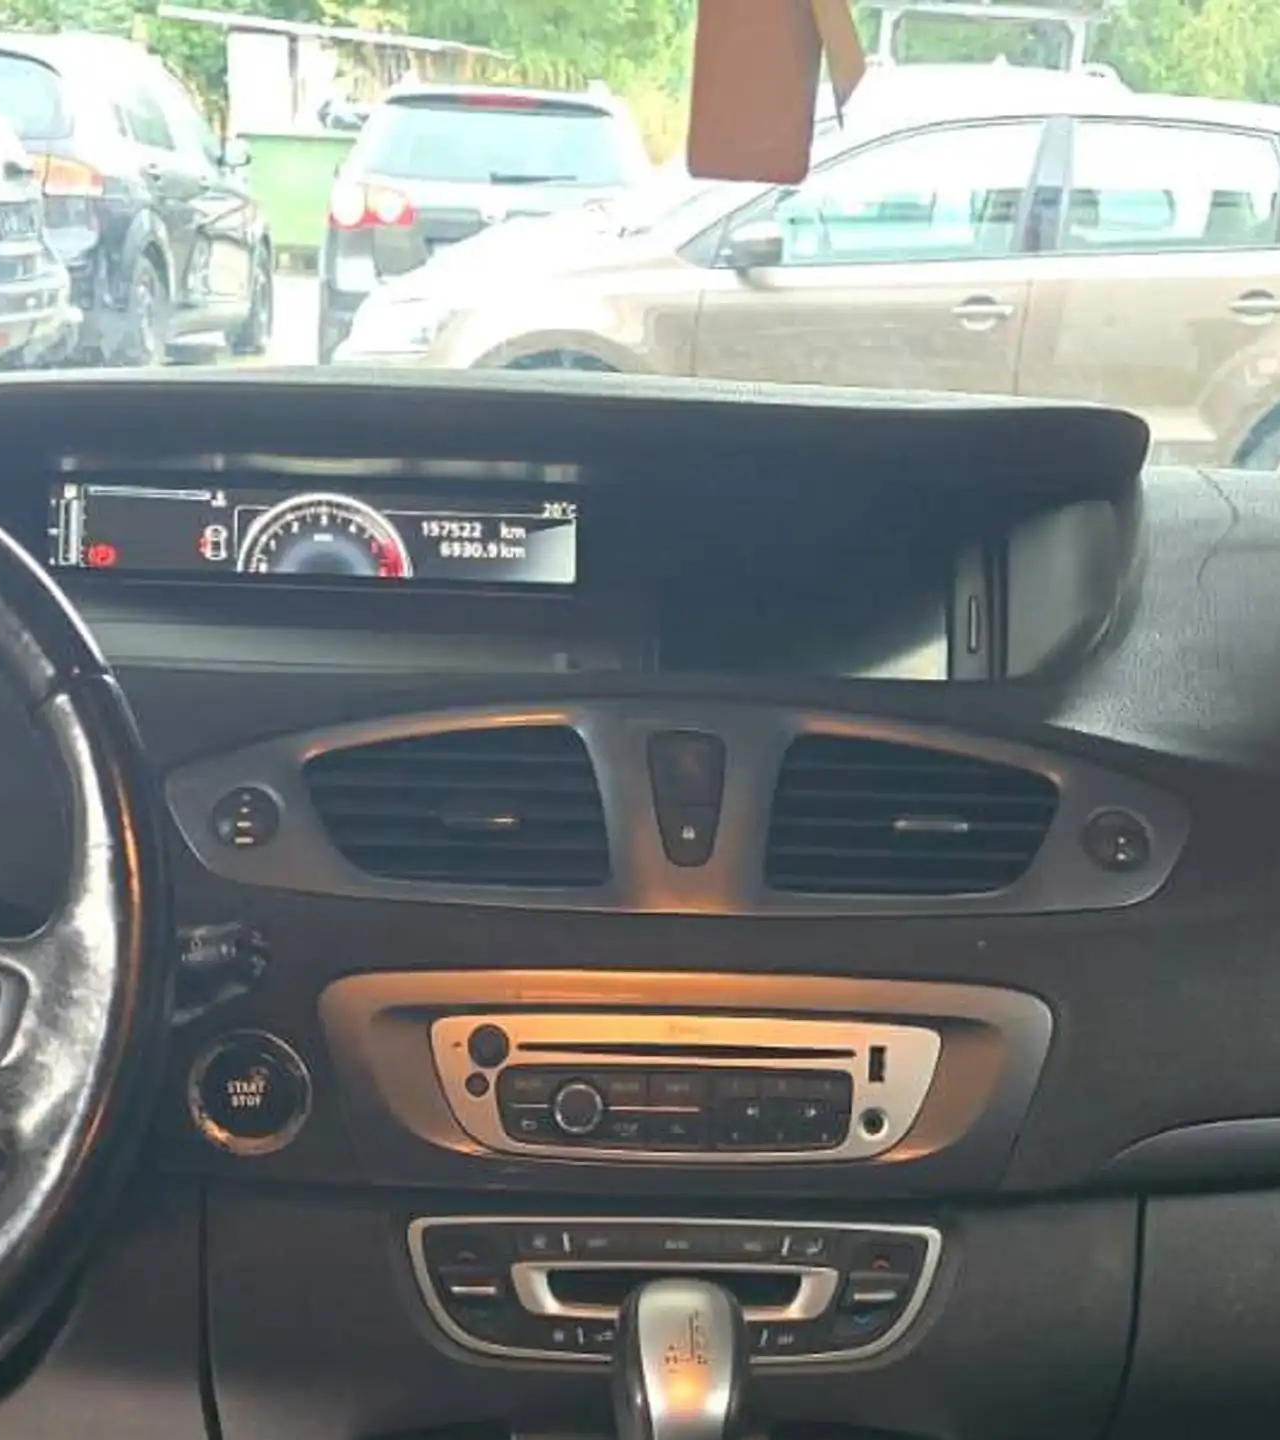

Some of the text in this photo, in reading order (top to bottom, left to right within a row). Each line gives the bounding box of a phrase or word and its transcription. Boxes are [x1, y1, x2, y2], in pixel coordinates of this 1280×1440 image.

[500, 521, 526, 538] km
[500, 541, 526, 558] km
[227, 1080, 265, 1094] START
[231, 1094, 261, 1108] STOP
